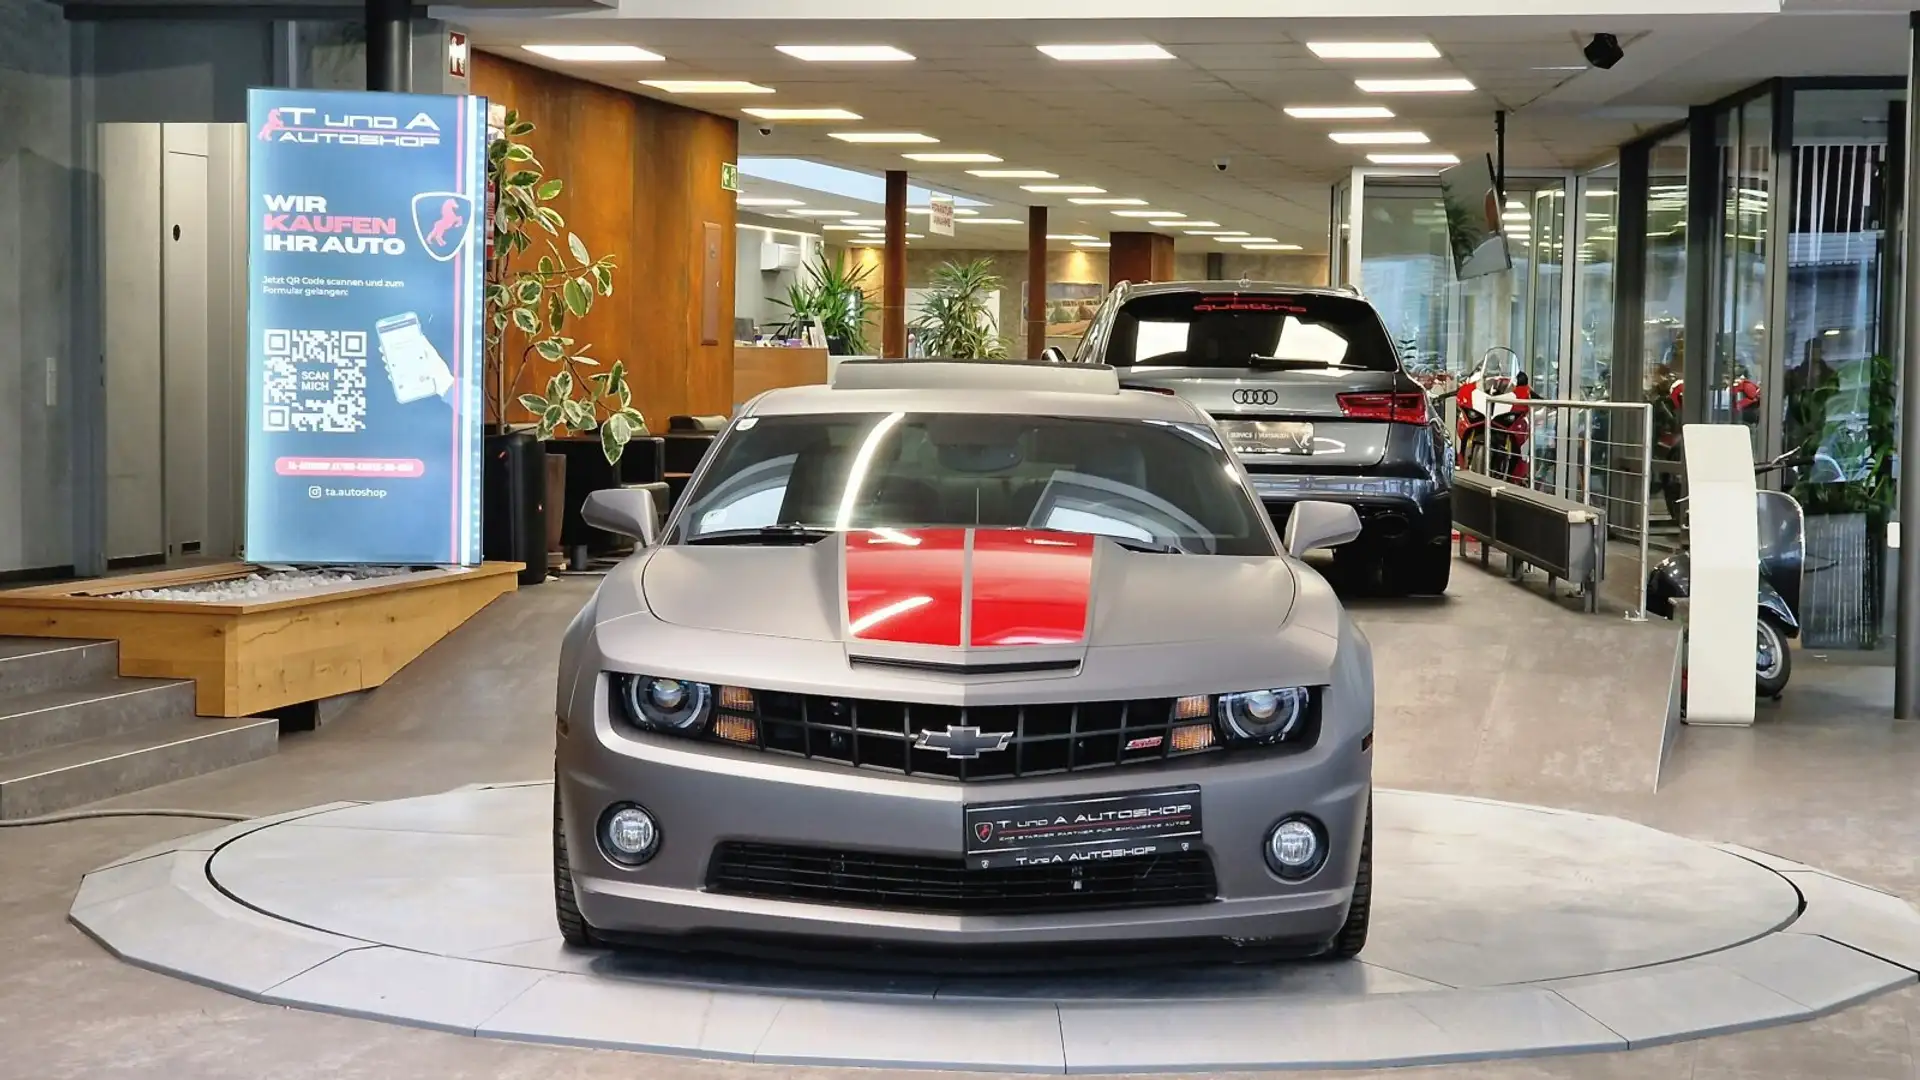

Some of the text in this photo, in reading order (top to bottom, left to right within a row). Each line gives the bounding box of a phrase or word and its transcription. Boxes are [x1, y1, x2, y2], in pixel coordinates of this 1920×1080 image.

[279, 107, 316, 125] T
[405, 112, 441, 131] A
[279, 131, 441, 147] AUTOSHOP
[263, 194, 327, 213] WIR
[263, 214, 397, 235] KAUFEN
[264, 235, 406, 255] IHR AUTO
[262, 275, 405, 288] Jetzt QR Code scannen und zum
[262, 285, 303, 295] Formular
[301, 371, 329, 381] SCAN
[301, 381, 329, 392] MICH
[325, 487, 388, 499] ta.autoshop
[996, 820, 1012, 829] T
[1054, 815, 1069, 825] A
[1074, 804, 1192, 823] AUTOSHOP
[1068, 845, 1157, 861] AUTOSHOP
